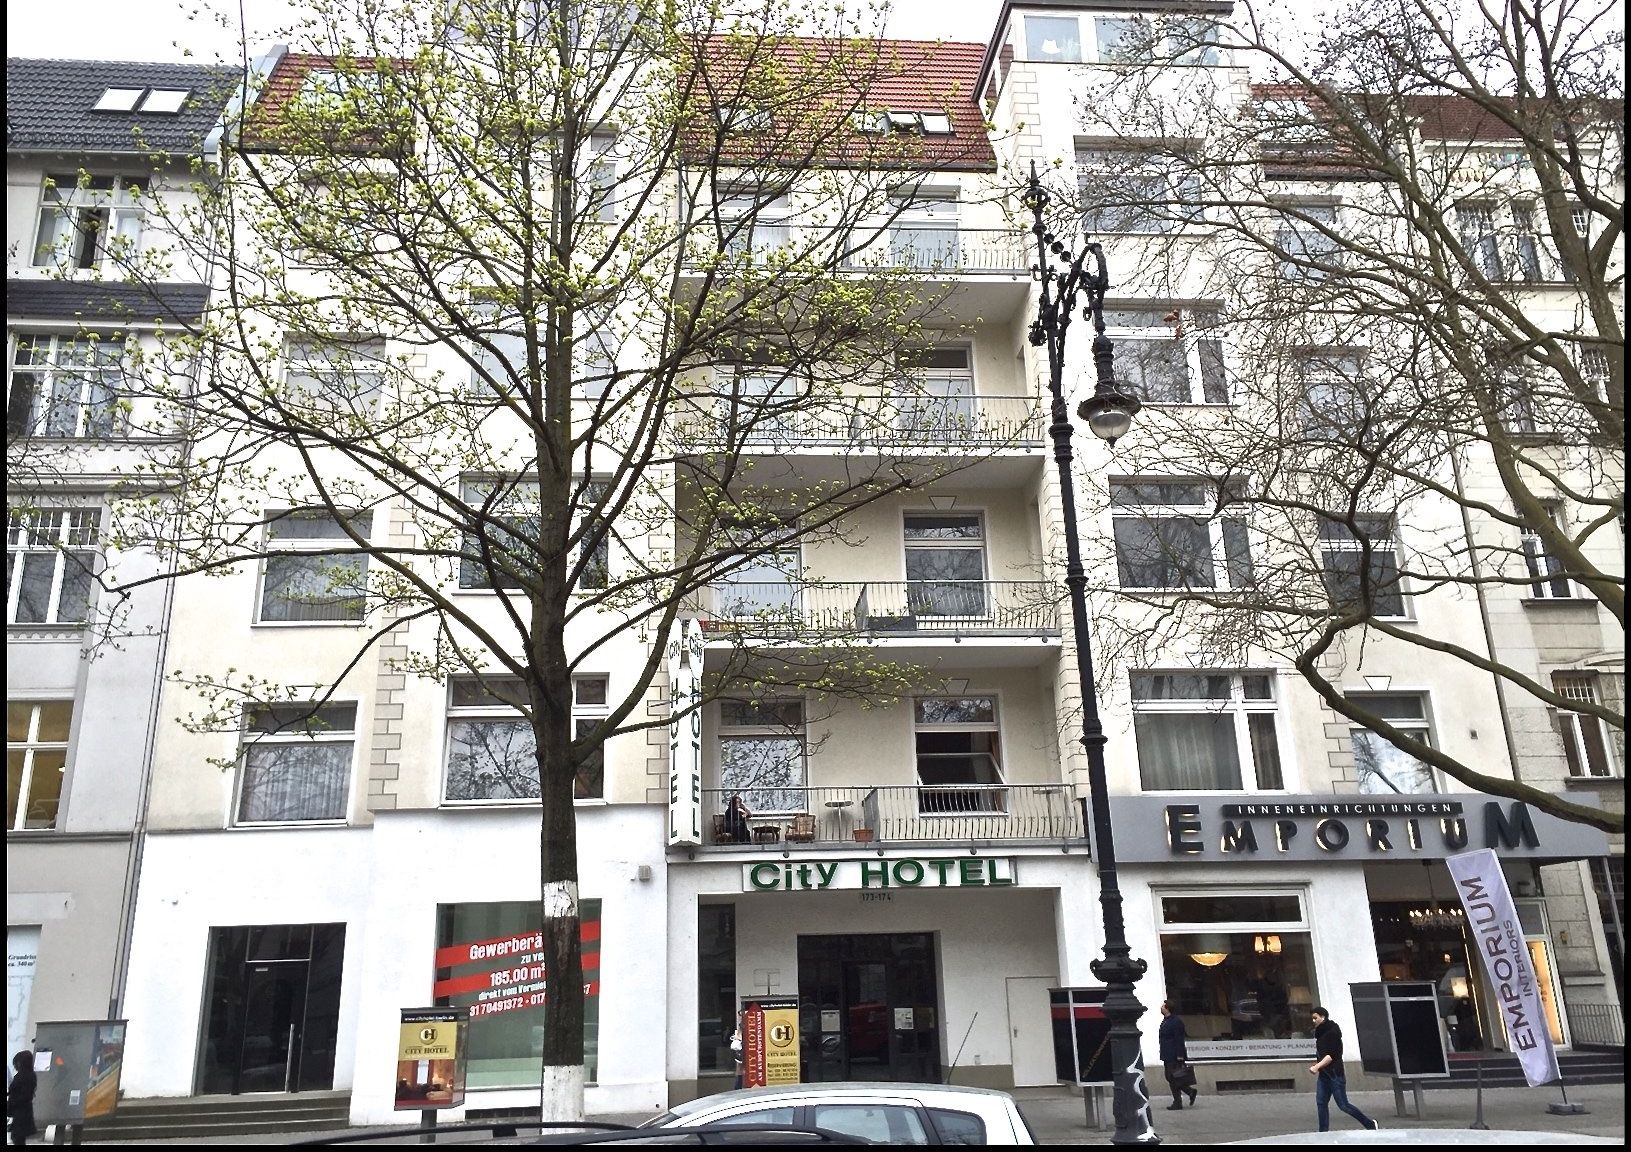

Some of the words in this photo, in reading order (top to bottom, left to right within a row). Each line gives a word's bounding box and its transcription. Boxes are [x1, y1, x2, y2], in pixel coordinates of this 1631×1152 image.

[691, 677, 700, 838] HOTEL
[1238, 804, 1452, 814] INNENEINRICHTUNGEN
[1165, 801, 1541, 853] EMPORIUM
[751, 862, 839, 889] City
[861, 859, 1013, 887] HOTEL
[861, 893, 892, 901] 173-174
[521, 955, 531, 964] zu
[530, 962, 546, 980] m²
[1461, 876, 1538, 1051] EMPORIUM
[1503, 919, 1533, 996] INTERIORS
[479, 991, 501, 1000] direkt
[502, 986, 518, 996] vom
[480, 996, 524, 1014] 70491372
[748, 1011, 757, 1051] HOTEL
[748, 1055, 757, 1082] CITY
